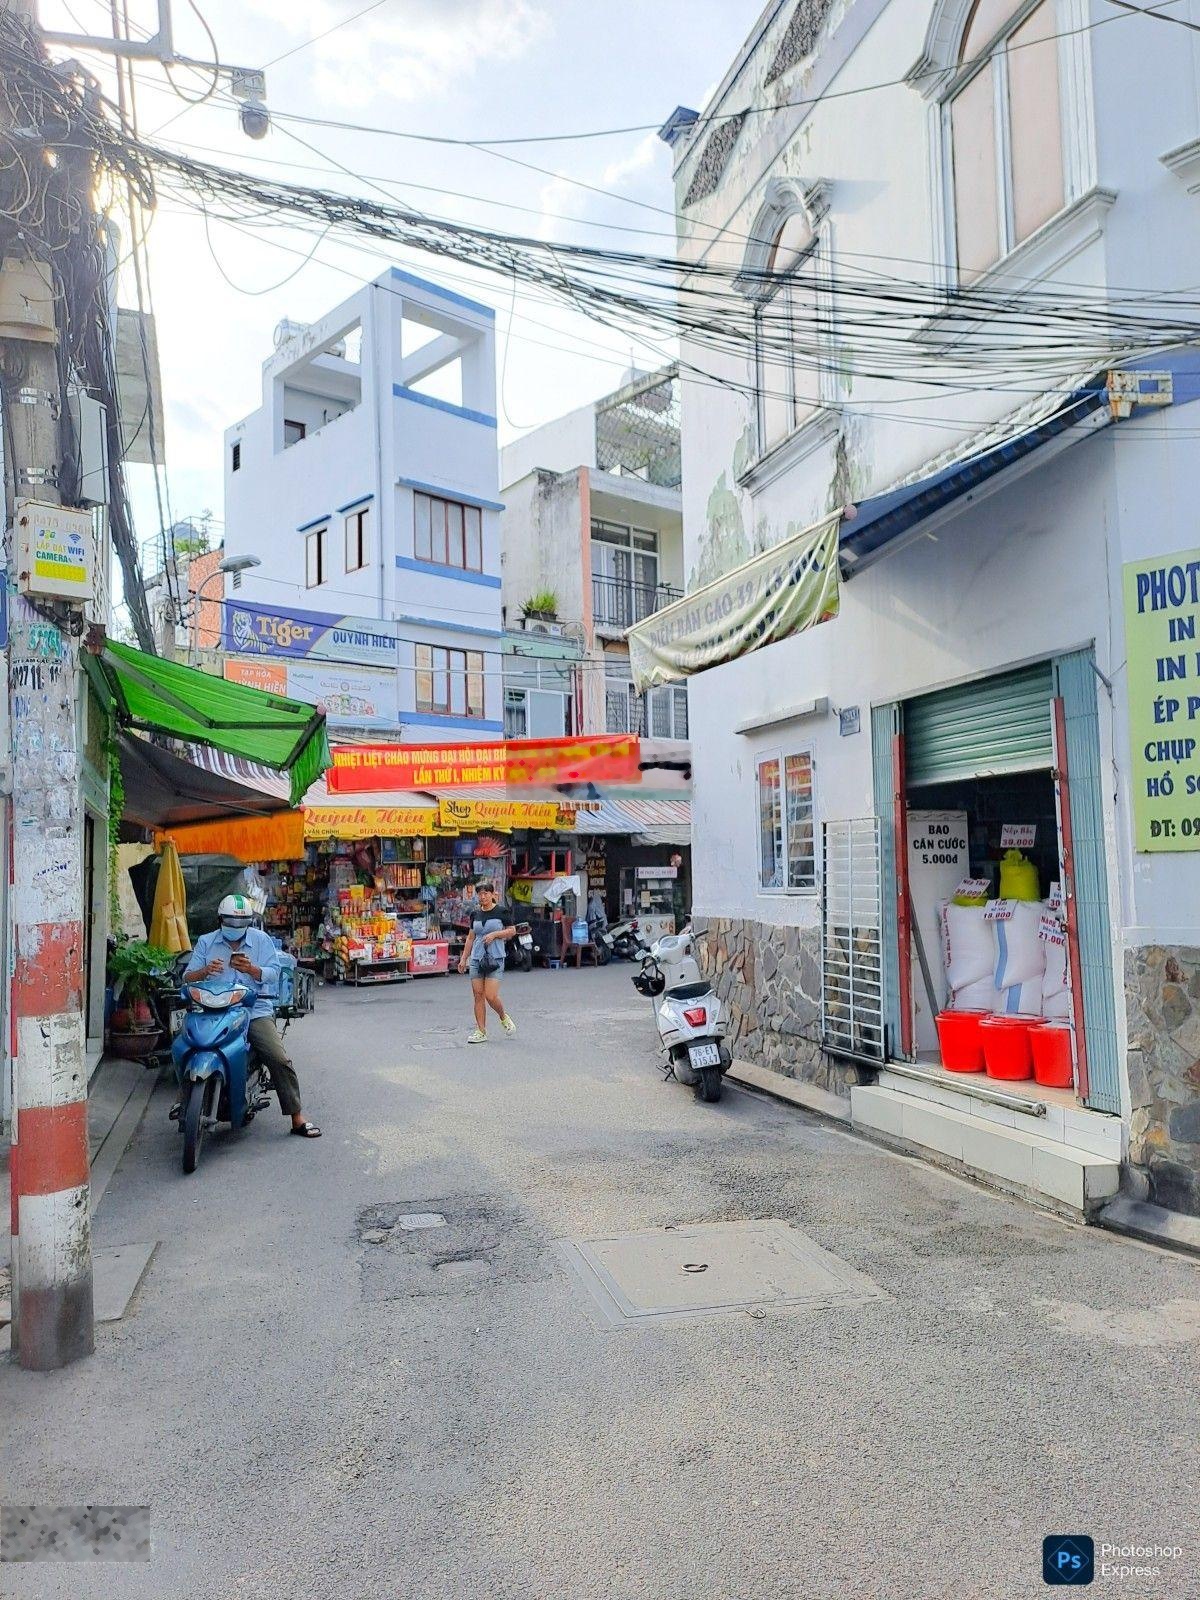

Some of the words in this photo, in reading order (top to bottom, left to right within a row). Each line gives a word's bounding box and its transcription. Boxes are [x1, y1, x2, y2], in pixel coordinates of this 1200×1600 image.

[36, 550, 68, 563] CAMERA
[67, 545, 85, 557] WIFI
[1136, 562, 1200, 613] PHOT
[256, 615, 314, 647] Tiger
[1168, 615, 1195, 643] IN
[1156, 655, 1186, 682] IN
[1153, 695, 1179, 724] ÉP
[334, 752, 361, 769] NHIỆT
[363, 752, 382, 769] LIỆT
[384, 749, 409, 765] CHÀO
[411, 749, 439, 765] MỪNG
[441, 749, 456, 765] ĐẠI
[476, 748, 492, 764] ĐẠI
[1144, 738, 1196, 764] CHỤP
[434, 767, 451, 783] THỨ
[461, 765, 491, 784] NHIỆM
[1146, 770, 1174, 797] HỒ
[444, 800, 472, 818] Shop
[928, 825, 949, 835] BAO
[1150, 819, 1176, 837] ĐT:
[937, 837, 966, 850] CƯỚC
[922, 854, 958, 864] 5.000đ
